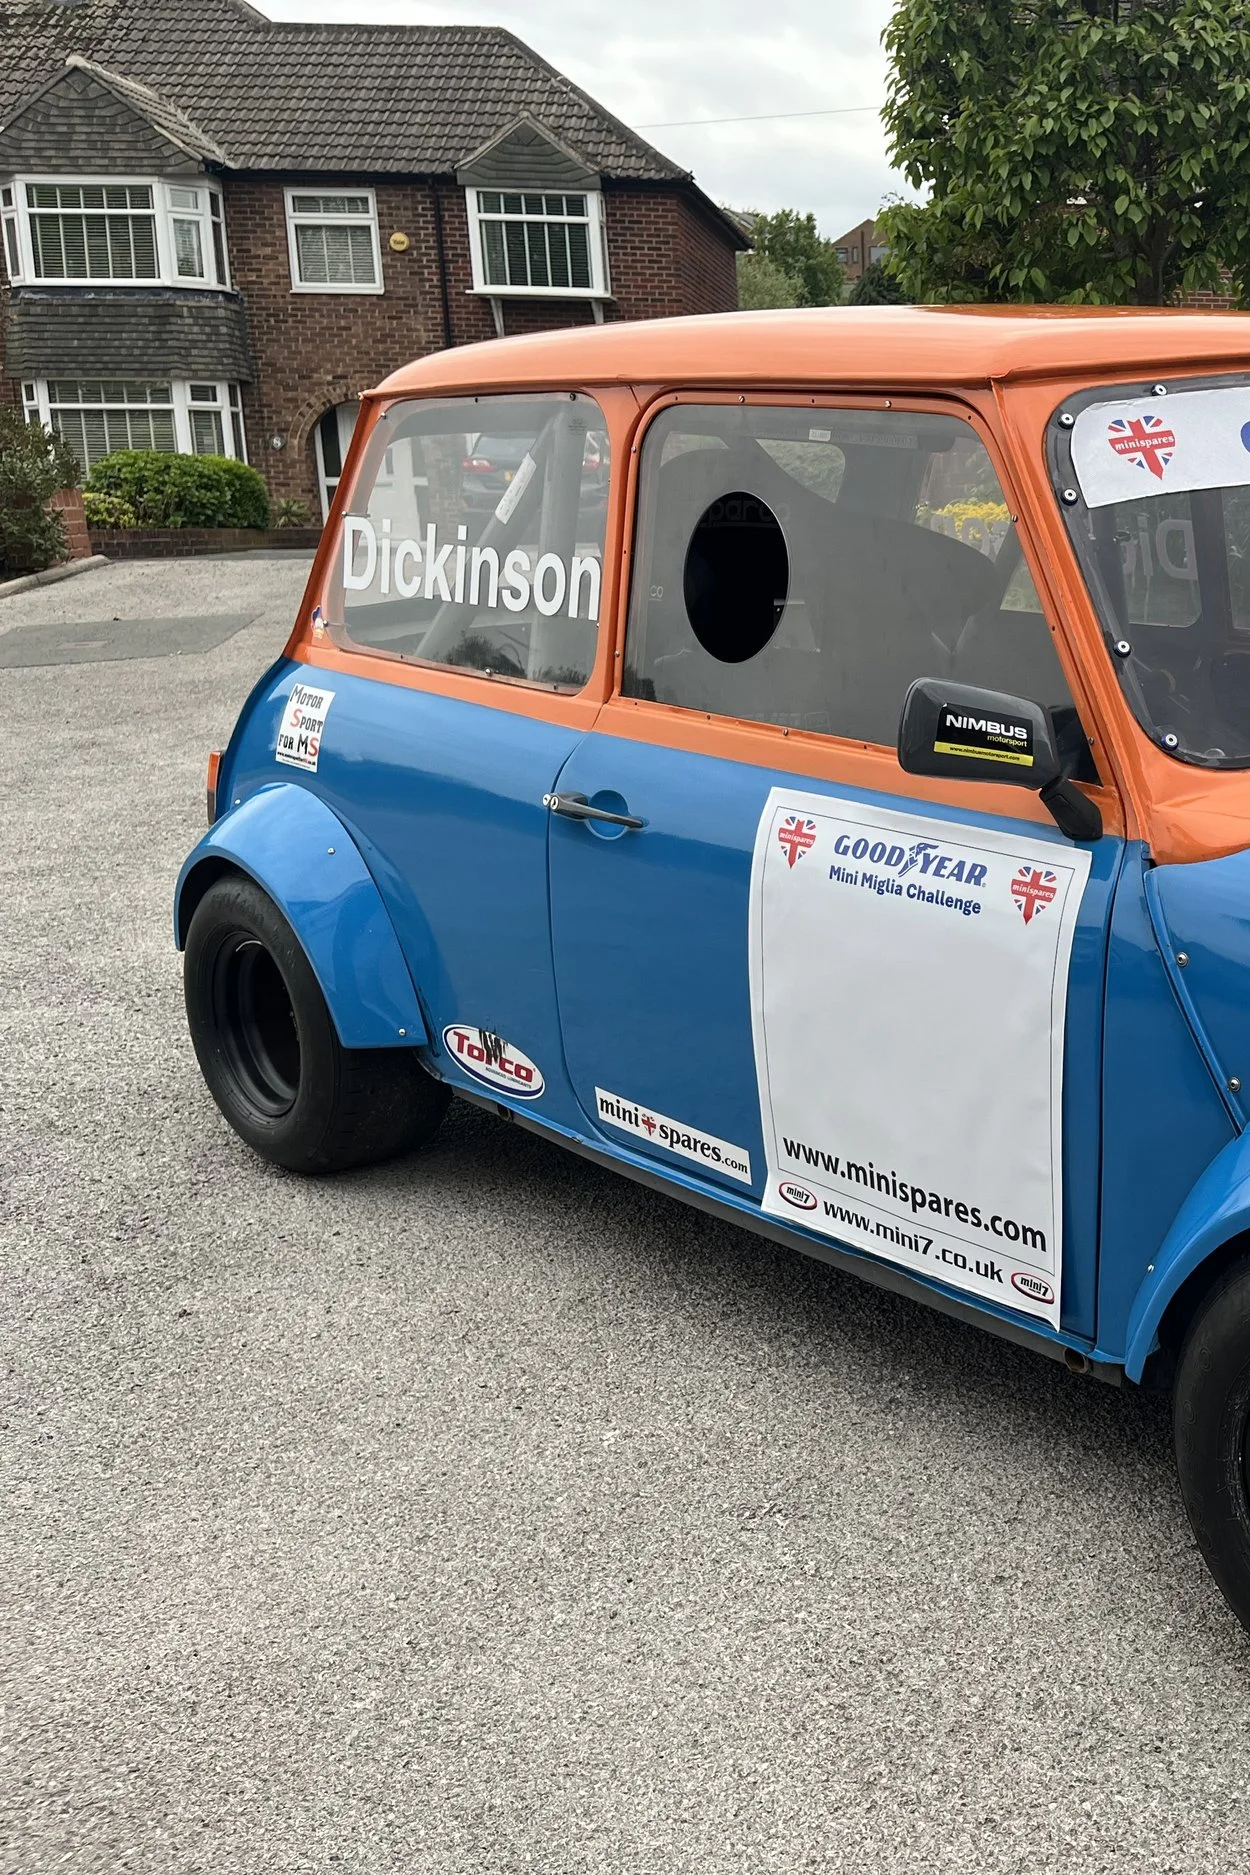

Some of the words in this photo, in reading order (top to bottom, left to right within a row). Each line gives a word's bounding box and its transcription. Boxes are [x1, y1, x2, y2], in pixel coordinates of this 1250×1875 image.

[1115, 436, 1174, 450] minispares
[343, 516, 601, 621] Dickinson
[945, 714, 1027, 739] NIMBUS
[297, 733, 319, 757] MS
[987, 735, 1028, 748] motorsport
[779, 832, 814, 845] minispares
[829, 865, 858, 886] Mini
[861, 873, 903, 896] Miglia
[906, 884, 981, 915] Challenge
[1012, 884, 1054, 899] minispares
[783, 1137, 1047, 1252] www.minispares.com
[786, 1186, 810, 1204] mini7
[823, 1200, 1004, 1284] www.mini7.co.uk
[1020, 1276, 1049, 1297] mini7
